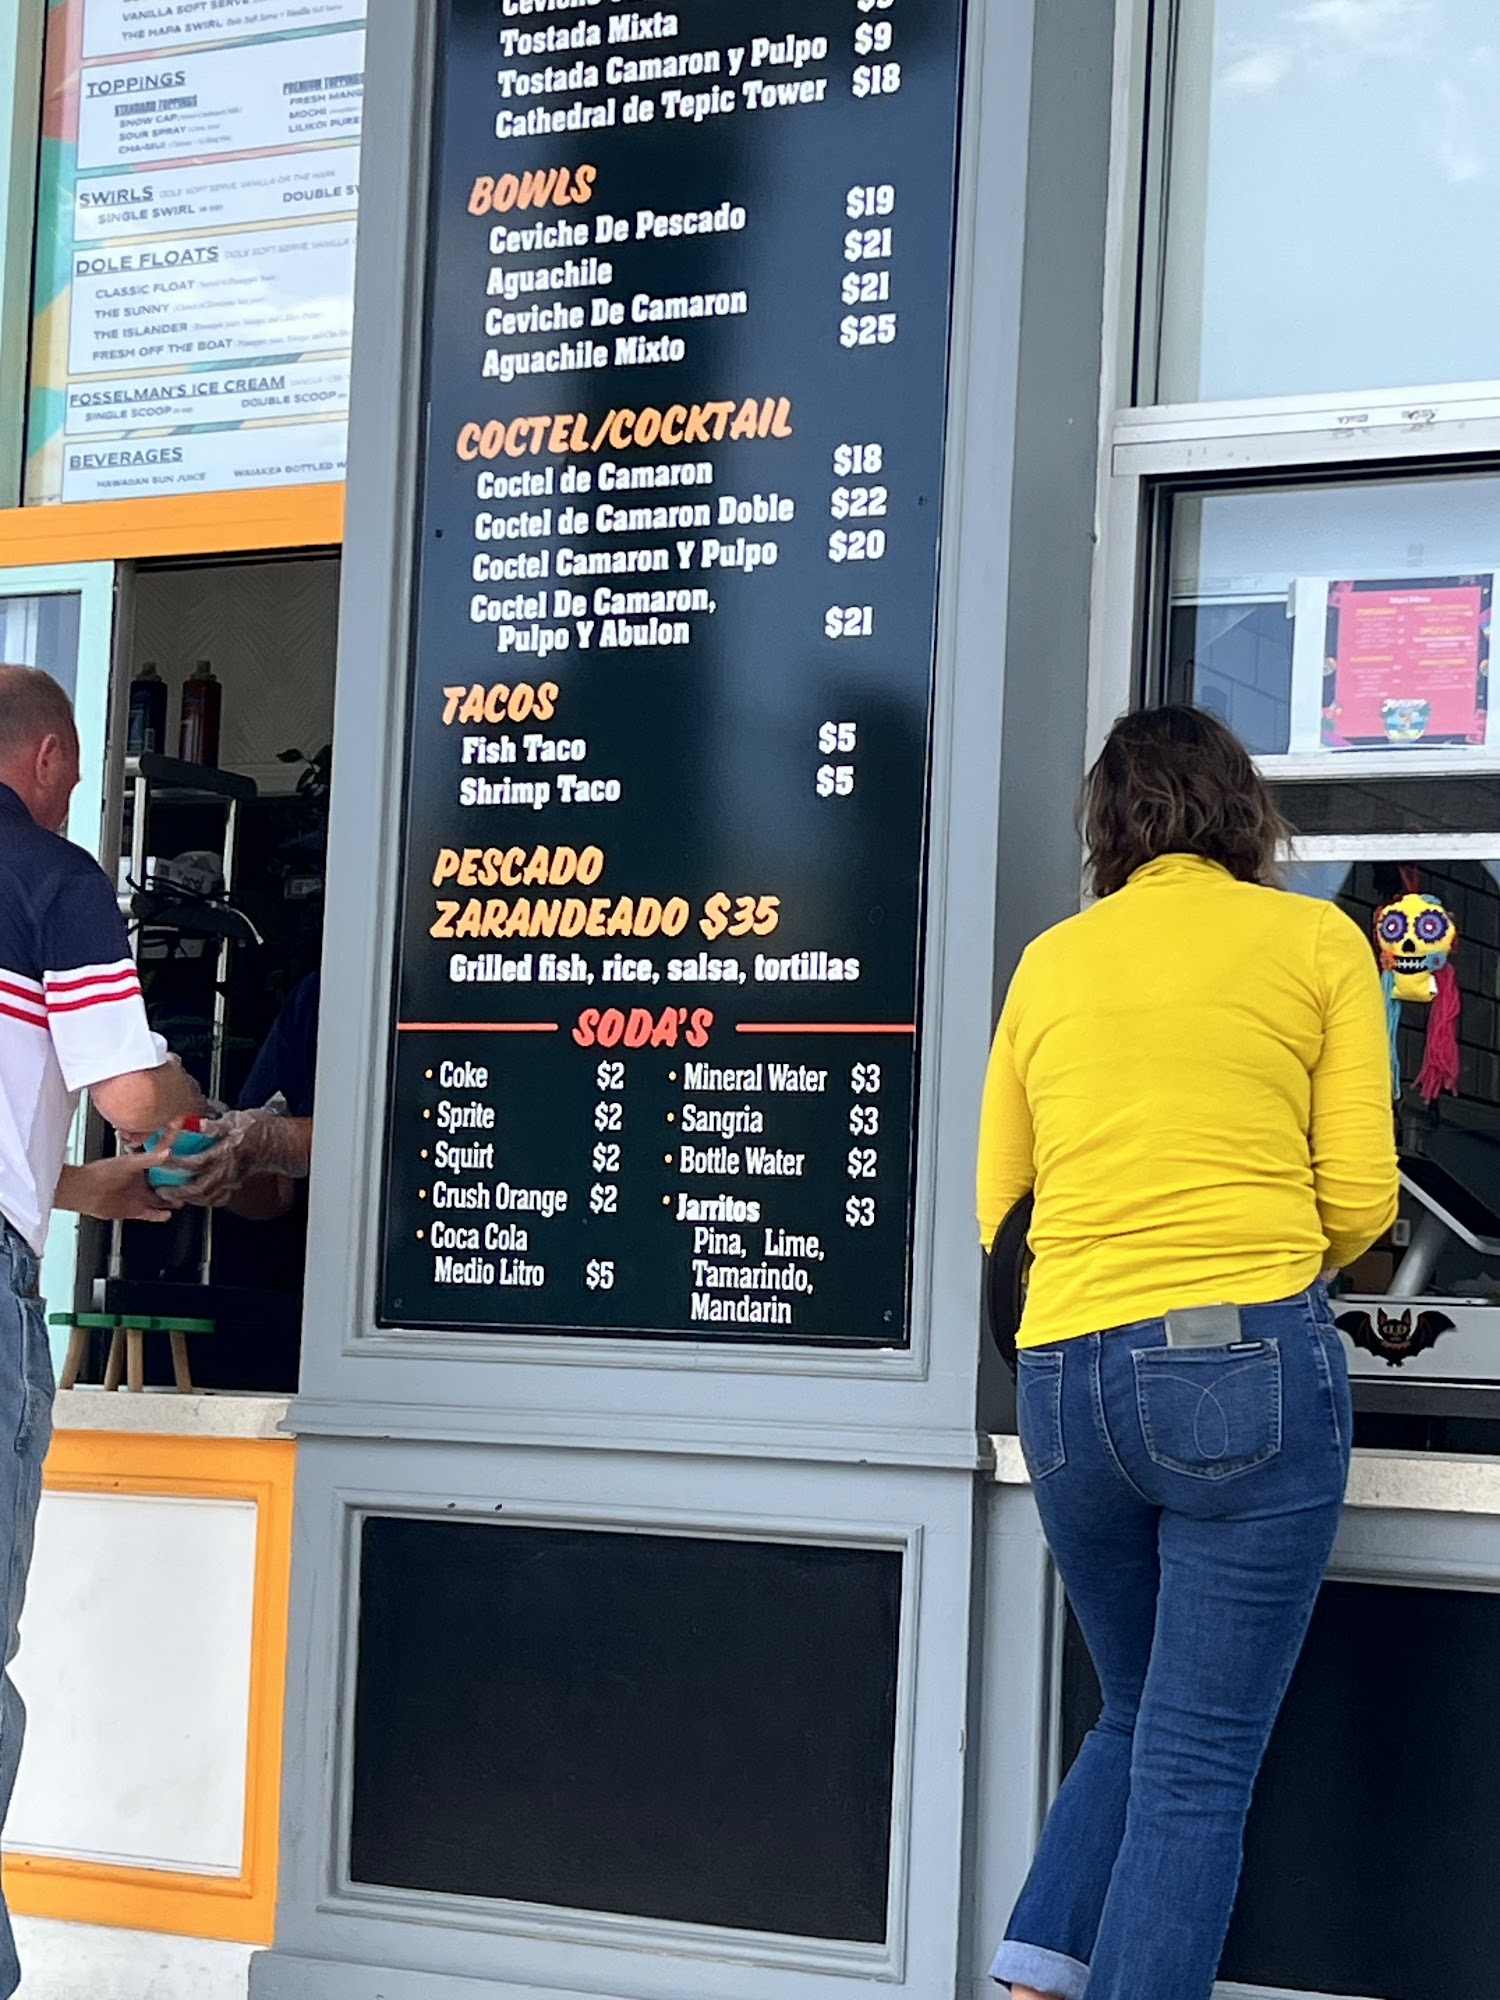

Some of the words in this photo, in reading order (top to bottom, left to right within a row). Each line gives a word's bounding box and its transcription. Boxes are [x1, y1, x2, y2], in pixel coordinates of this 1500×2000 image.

[122, 7, 173, 21] VANILLA
[177, 2, 207, 15] SOFT
[185, 20, 223, 32] SWIRL
[499, 19, 602, 58] Tostada
[607, 11, 678, 44] Mixta
[497, 60, 599, 99] Tostada
[606, 50, 721, 85] Camaron
[727, 47, 745, 74] y
[750, 34, 828, 69] Pulpo
[854, 21, 892, 56] $9
[87, 71, 185, 97] TOPPINGS
[290, 94, 326, 106] FRESH
[495, 97, 616, 139] Cathedral
[622, 94, 655, 124] de
[661, 84, 736, 123] Tepic
[742, 78, 828, 110] Tower
[852, 62, 901, 99] $18
[156, 114, 177, 123] CAP
[289, 107, 327, 119] MOCHI
[120, 131, 148, 141] SOUR
[152, 126, 187, 137] SPRAY
[79, 185, 154, 207] SWIRLS
[282, 186, 343, 203] DOUBLE
[467, 164, 597, 216] BOWLS
[98, 209, 148, 224] SINGLE
[152, 205, 195, 218] SWIRL
[489, 219, 589, 255] Ceviche
[594, 214, 629, 244] De
[635, 201, 746, 240] Pescado
[845, 184, 895, 220] $19
[76, 255, 133, 275] DOLE
[140, 245, 219, 268] FLOATS
[485, 257, 613, 301] Aguachile
[844, 226, 892, 263] $21
[95, 284, 150, 299] CLASSIC
[153, 280, 195, 293] FLOAT
[484, 301, 585, 337] Ceviche
[590, 297, 625, 327] De
[631, 290, 748, 323] Camaron
[841, 270, 890, 306] $21
[95, 308, 120, 319] THE
[123, 304, 170, 317] SUNNY
[93, 329, 119, 340] THE
[122, 323, 188, 338] ISLANDER
[93, 348, 136, 360] FRESH
[139, 345, 164, 357] OFF
[167, 342, 193, 353] THE
[198, 338, 233, 351] BOAT
[481, 340, 609, 383] Aguachile
[614, 335, 685, 366] Mixto
[839, 312, 897, 349] $25
[70, 384, 186, 407] FOSSELMAN'S
[192, 381, 219, 397] ICE
[224, 375, 285, 394] CREAM
[241, 395, 290, 408] DOUBLE
[294, 391, 337, 403] SCOOP
[85, 409, 128, 422] SINGLE
[131, 406, 172, 418] SCOOP
[456, 396, 793, 461] COCTEL/COCKTAIL
[69, 447, 183, 470] BEVERAGES
[285, 462, 334, 474] BOTTLED
[476, 466, 554, 500] Coctel
[559, 465, 592, 494] de
[597, 461, 713, 491] Camaron
[833, 443, 883, 477] $18
[474, 507, 552, 541] Coctel
[557, 506, 589, 536] de
[595, 503, 711, 533] Camaron
[717, 492, 795, 525] Doble
[830, 485, 888, 520] $22
[472, 549, 550, 582] Coctel
[555, 547, 670, 577] Camaron
[676, 540, 696, 570] Y
[700, 537, 778, 573] Pulpo
[828, 528, 886, 563] $20
[470, 590, 548, 623] Coctel
[552, 589, 588, 618] De
[593, 587, 716, 616] Camaron,
[497, 623, 570, 658] Pulpo
[575, 620, 595, 649] Y
[598, 616, 690, 648] Abulon
[824, 605, 873, 639] $21
[442, 681, 559, 726] TACOS
[461, 735, 517, 765] Fish
[522, 733, 586, 763] Taco
[818, 721, 857, 755] $5
[459, 776, 550, 810] Shrimp
[556, 774, 621, 803] Taco
[816, 764, 854, 798] $5
[432, 845, 604, 887] PESCADO
[429, 895, 690, 939] ZARANDEADO
[699, 892, 781, 941] $35
[449, 953, 533, 983] Grilled
[537, 953, 595, 986] fish,
[601, 953, 660, 985] rice,
[667, 952, 747, 985] salsa,
[754, 951, 860, 982] tortillas
[572, 1006, 714, 1048] SODA'S
[439, 1060, 488, 1089] Coke
[596, 1059, 625, 1091] $2
[683, 1062, 763, 1092] Mineral
[767, 1063, 828, 1092] Water
[851, 1062, 881, 1094] $3
[437, 1100, 495, 1135] Sprite
[594, 1101, 623, 1132] $2
[681, 1103, 763, 1140] Sangria
[849, 1103, 879, 1136] $3
[434, 1140, 494, 1175] Squirt
[592, 1141, 621, 1173] $2
[679, 1145, 740, 1175] Bottle
[745, 1146, 805, 1176] Water
[847, 1146, 877, 1179] $2
[432, 1180, 490, 1210] Crush
[495, 1182, 568, 1218] Orange
[589, 1182, 618, 1214] $2
[675, 1193, 761, 1223] Jarritos
[845, 1194, 875, 1228] $3
[430, 1220, 480, 1250] Coca
[484, 1222, 528, 1251] Cola
[693, 1226, 747, 1259] Pina,
[764, 1227, 825, 1261] Lime,
[434, 1255, 495, 1285] Medio
[499, 1257, 545, 1287] Litro
[586, 1258, 614, 1290] $5
[692, 1258, 814, 1295] Tamarindo,
[690, 1291, 792, 1324] Mandarin
